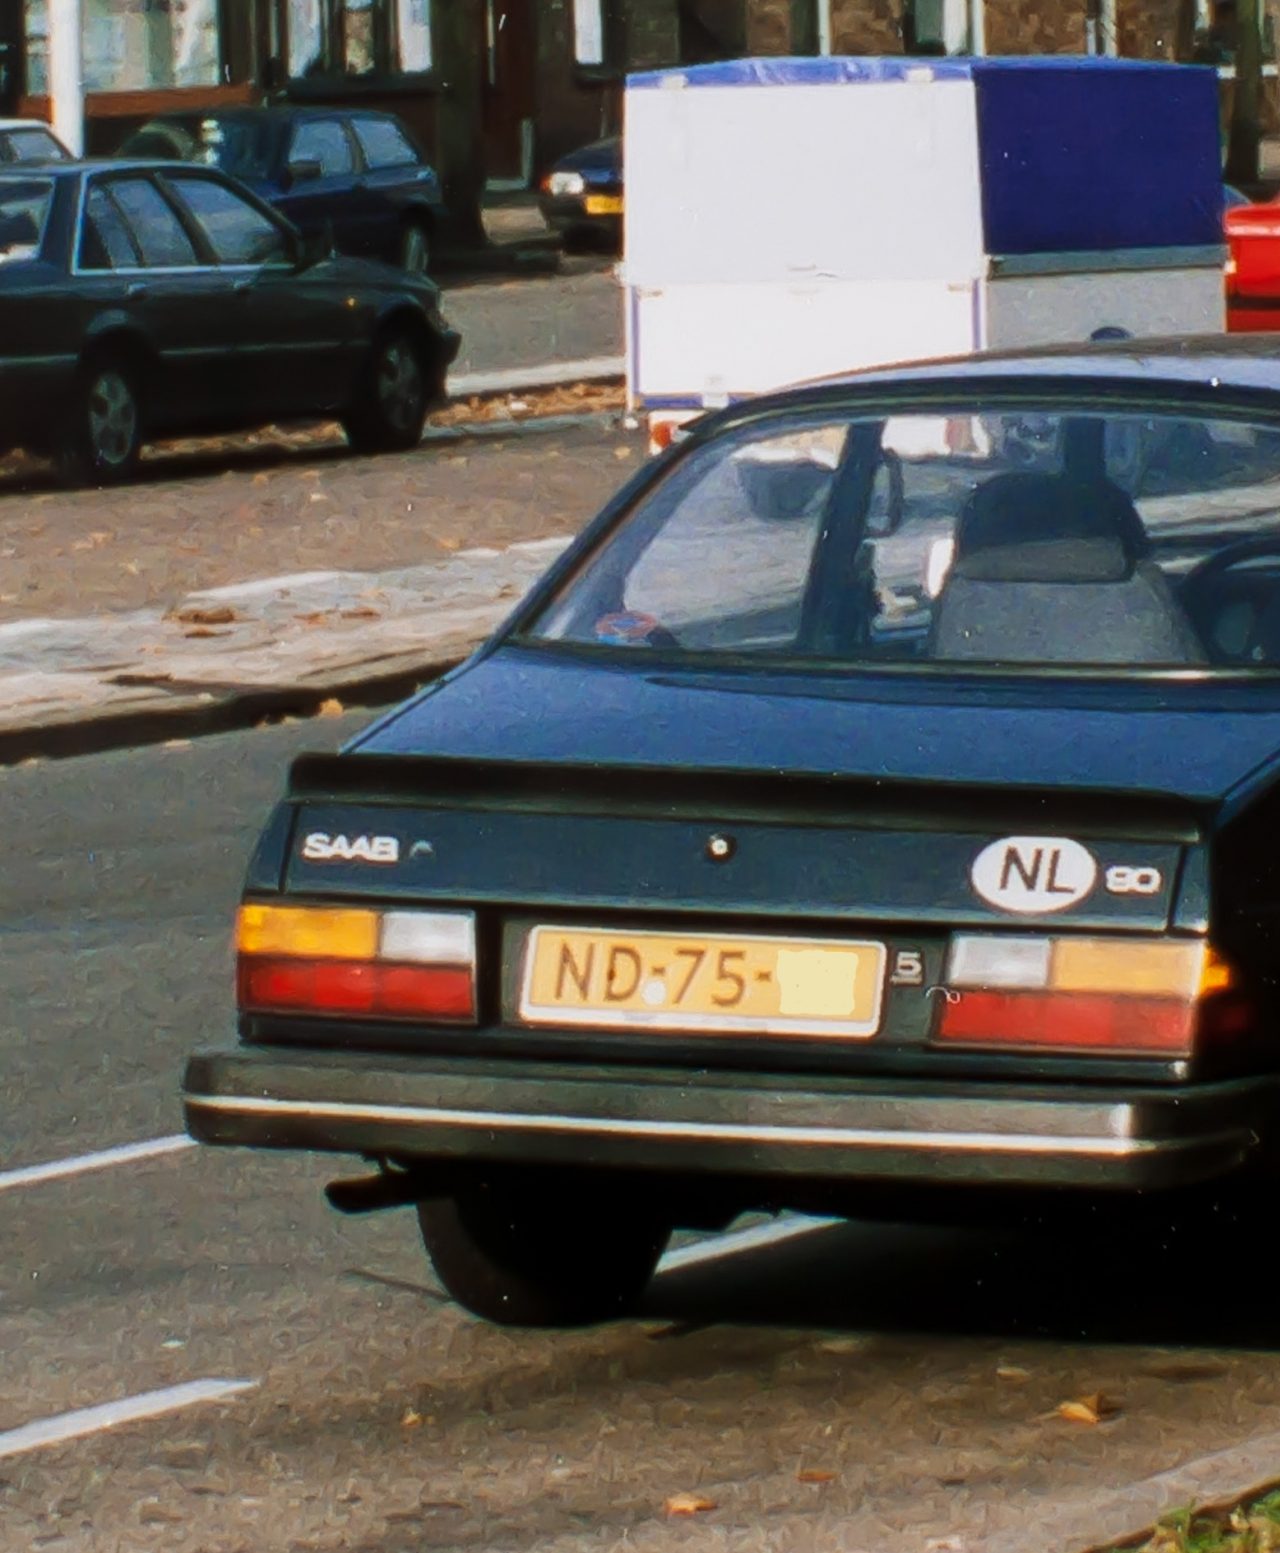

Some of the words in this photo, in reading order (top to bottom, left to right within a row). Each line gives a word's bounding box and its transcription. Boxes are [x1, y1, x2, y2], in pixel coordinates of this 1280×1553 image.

[303, 832, 399, 862] SAAB
[999, 846, 1076, 895] NL
[554, 942, 858, 1014] ND-75-
